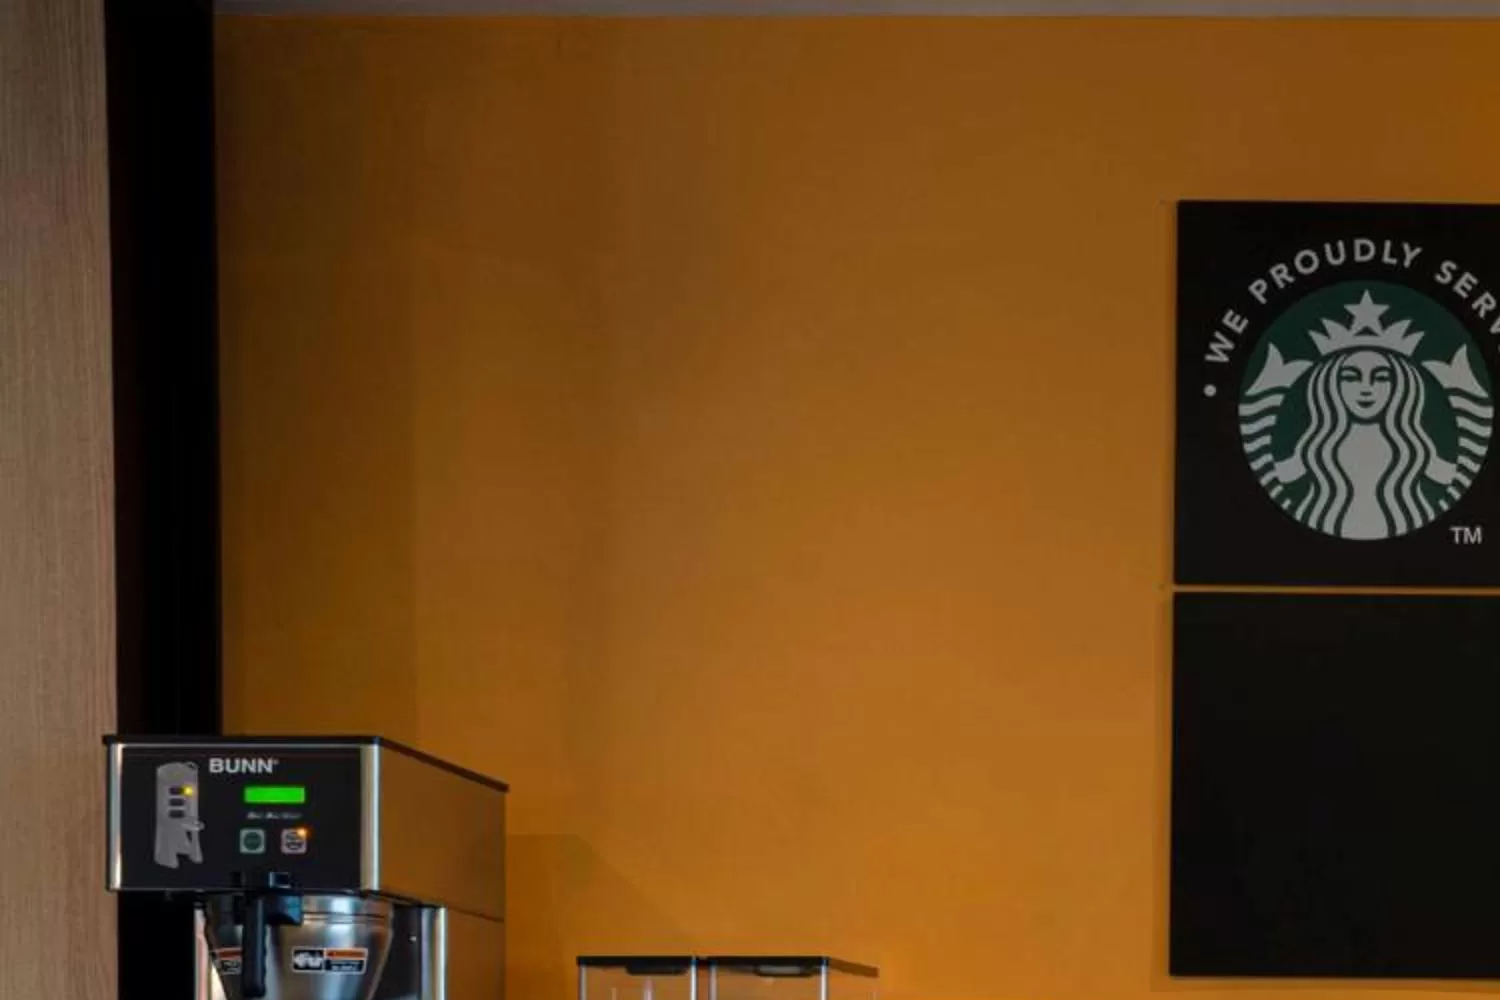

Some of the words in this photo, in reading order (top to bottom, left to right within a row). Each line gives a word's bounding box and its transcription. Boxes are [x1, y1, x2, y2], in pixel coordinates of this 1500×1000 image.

[1205, 309, 1249, 365] WE
[1248, 238, 1423, 305] PROUDLY
[1450, 526, 1482, 544] TM
